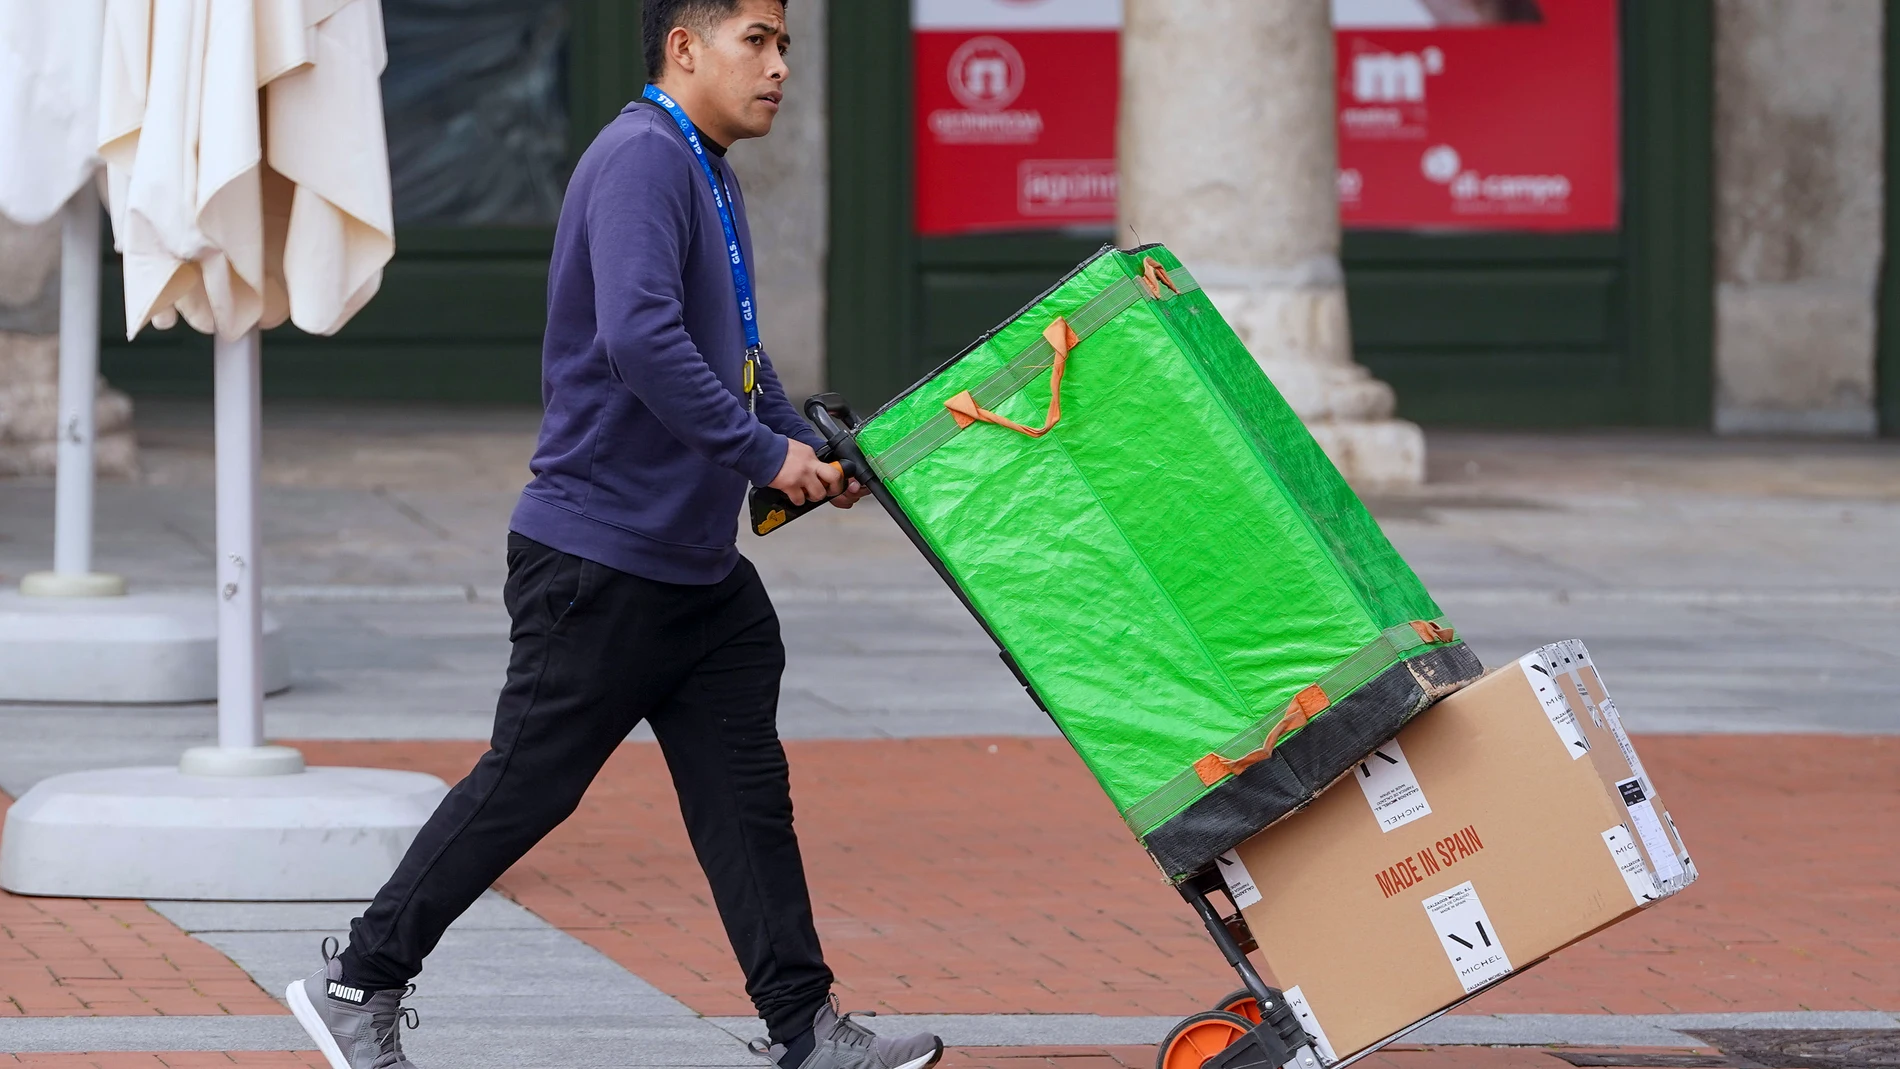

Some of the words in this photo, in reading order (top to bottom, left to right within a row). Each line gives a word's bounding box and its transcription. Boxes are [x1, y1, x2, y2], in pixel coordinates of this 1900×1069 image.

[689, 132, 703, 155] GLS.
[713, 184, 723, 208] GLS.
[729, 241, 741, 265] GLS.
[741, 297, 753, 321] GLS.
[1397, 787, 1419, 801] CALZADOS
[1383, 802, 1425, 825] MICHEL
[1374, 856, 1424, 899] MADE
[1416, 847, 1441, 877] IN
[1435, 824, 1484, 867] SPAIN
[1426, 897, 1448, 910] CALZADOS
[1461, 954, 1502, 976] MICHEL
[328, 982, 364, 1002] PUMA
[1466, 978, 1488, 992] CALZADOS
